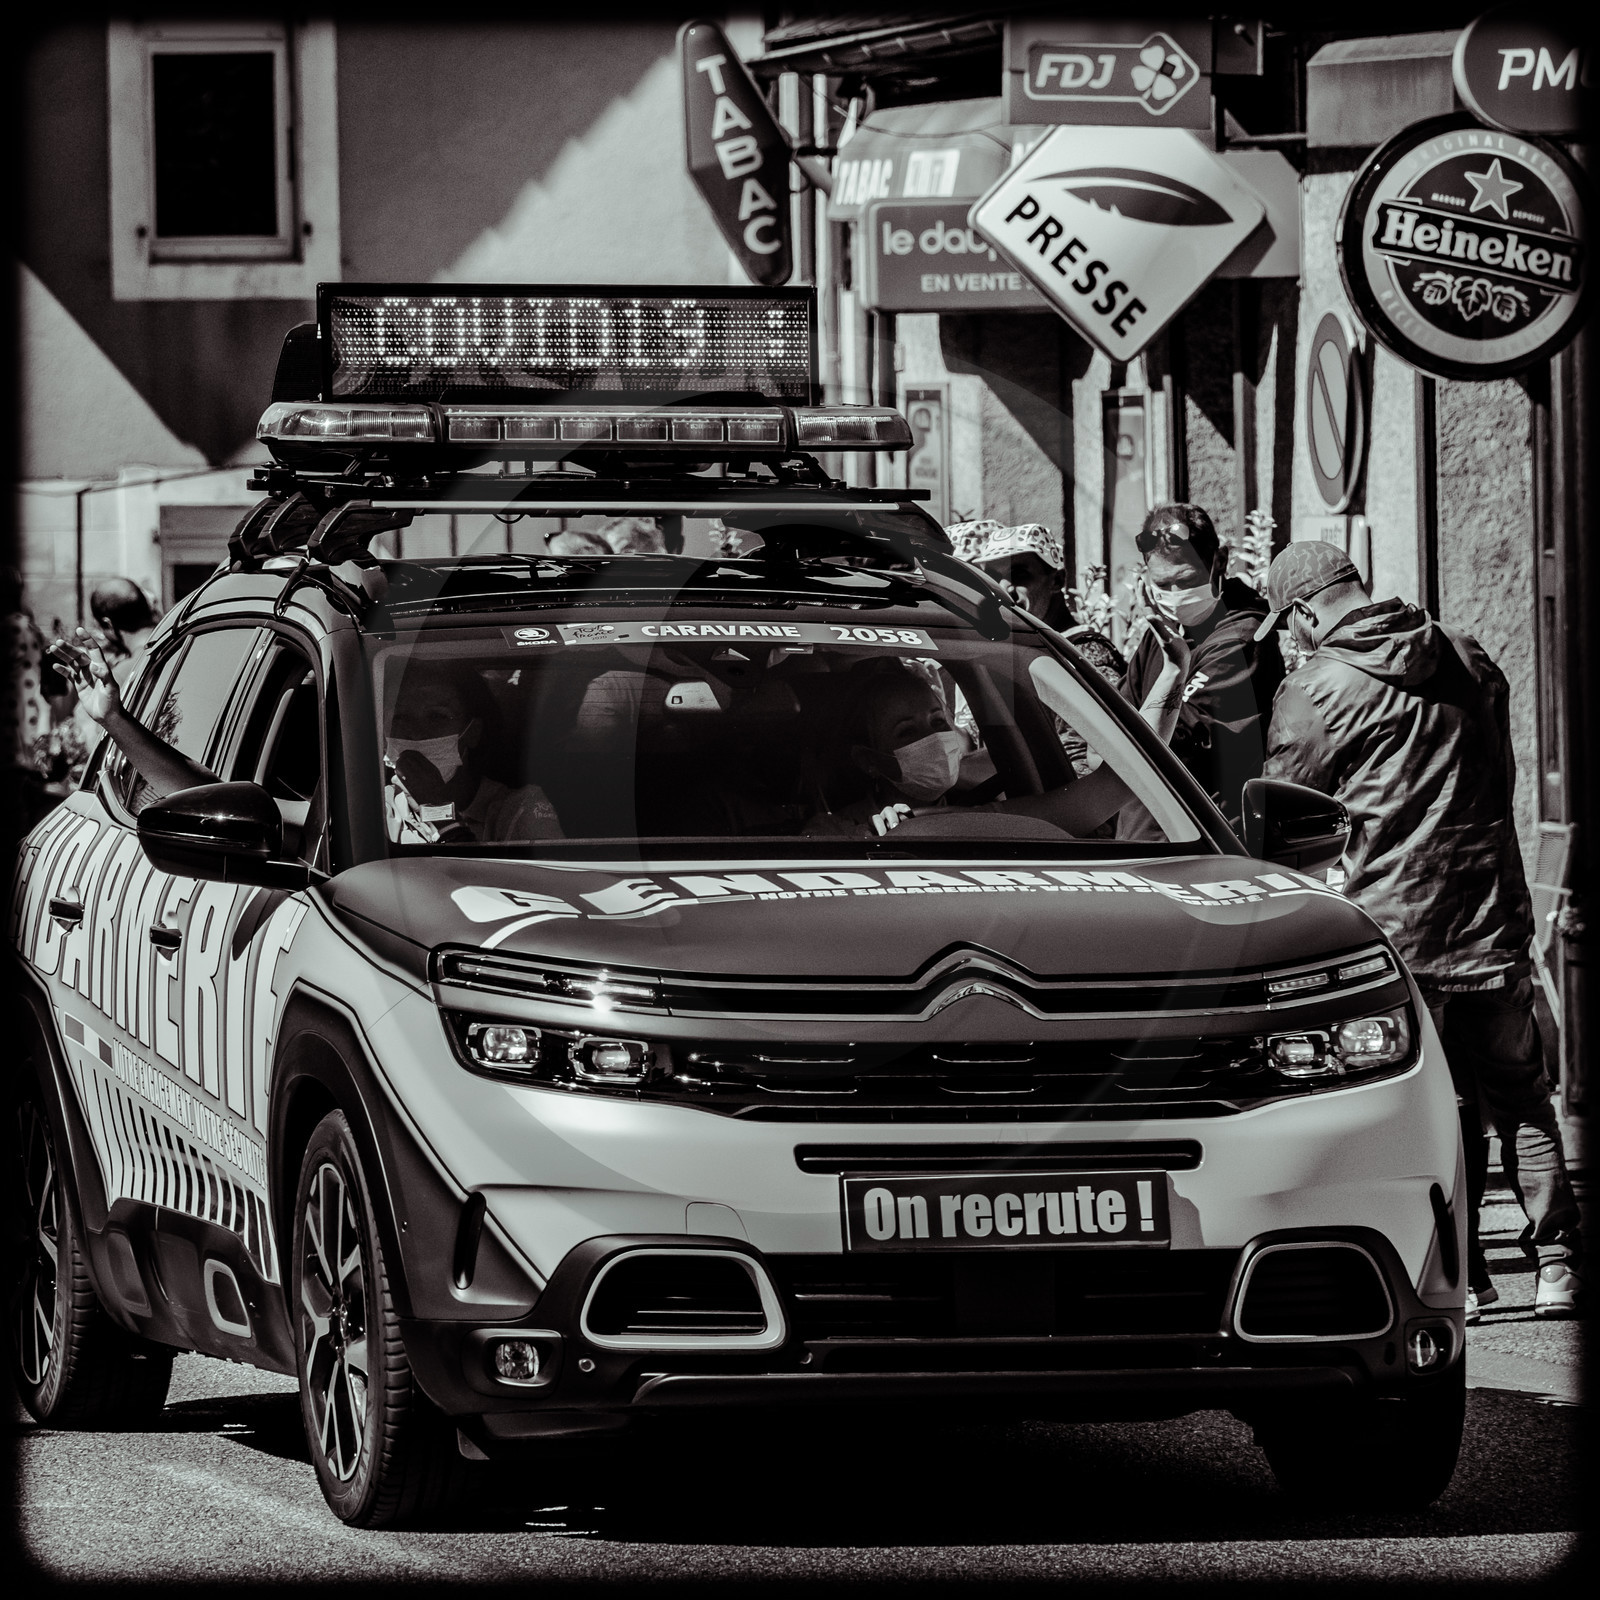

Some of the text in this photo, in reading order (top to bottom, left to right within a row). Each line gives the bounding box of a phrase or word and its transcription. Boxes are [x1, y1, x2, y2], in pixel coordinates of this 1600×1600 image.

[1035, 53, 1117, 89] FDJ
[696, 53, 782, 255] TABAC
[882, 221, 915, 256] le
[1380, 208, 1573, 282] Heineken
[920, 272, 1022, 293] EN VENTE
[1004, 194, 1147, 338] PRESSE
[641, 623, 802, 639] CARAVANE
[829, 625, 923, 646] 2058
[757, 889, 848, 901] NOTRE
[1039, 885, 1130, 893] VOTRE
[113, 1037, 140, 1095] NOTRE
[192, 1096, 225, 1157] VOTRE
[863, 1180, 1155, 1241] On recrute !
